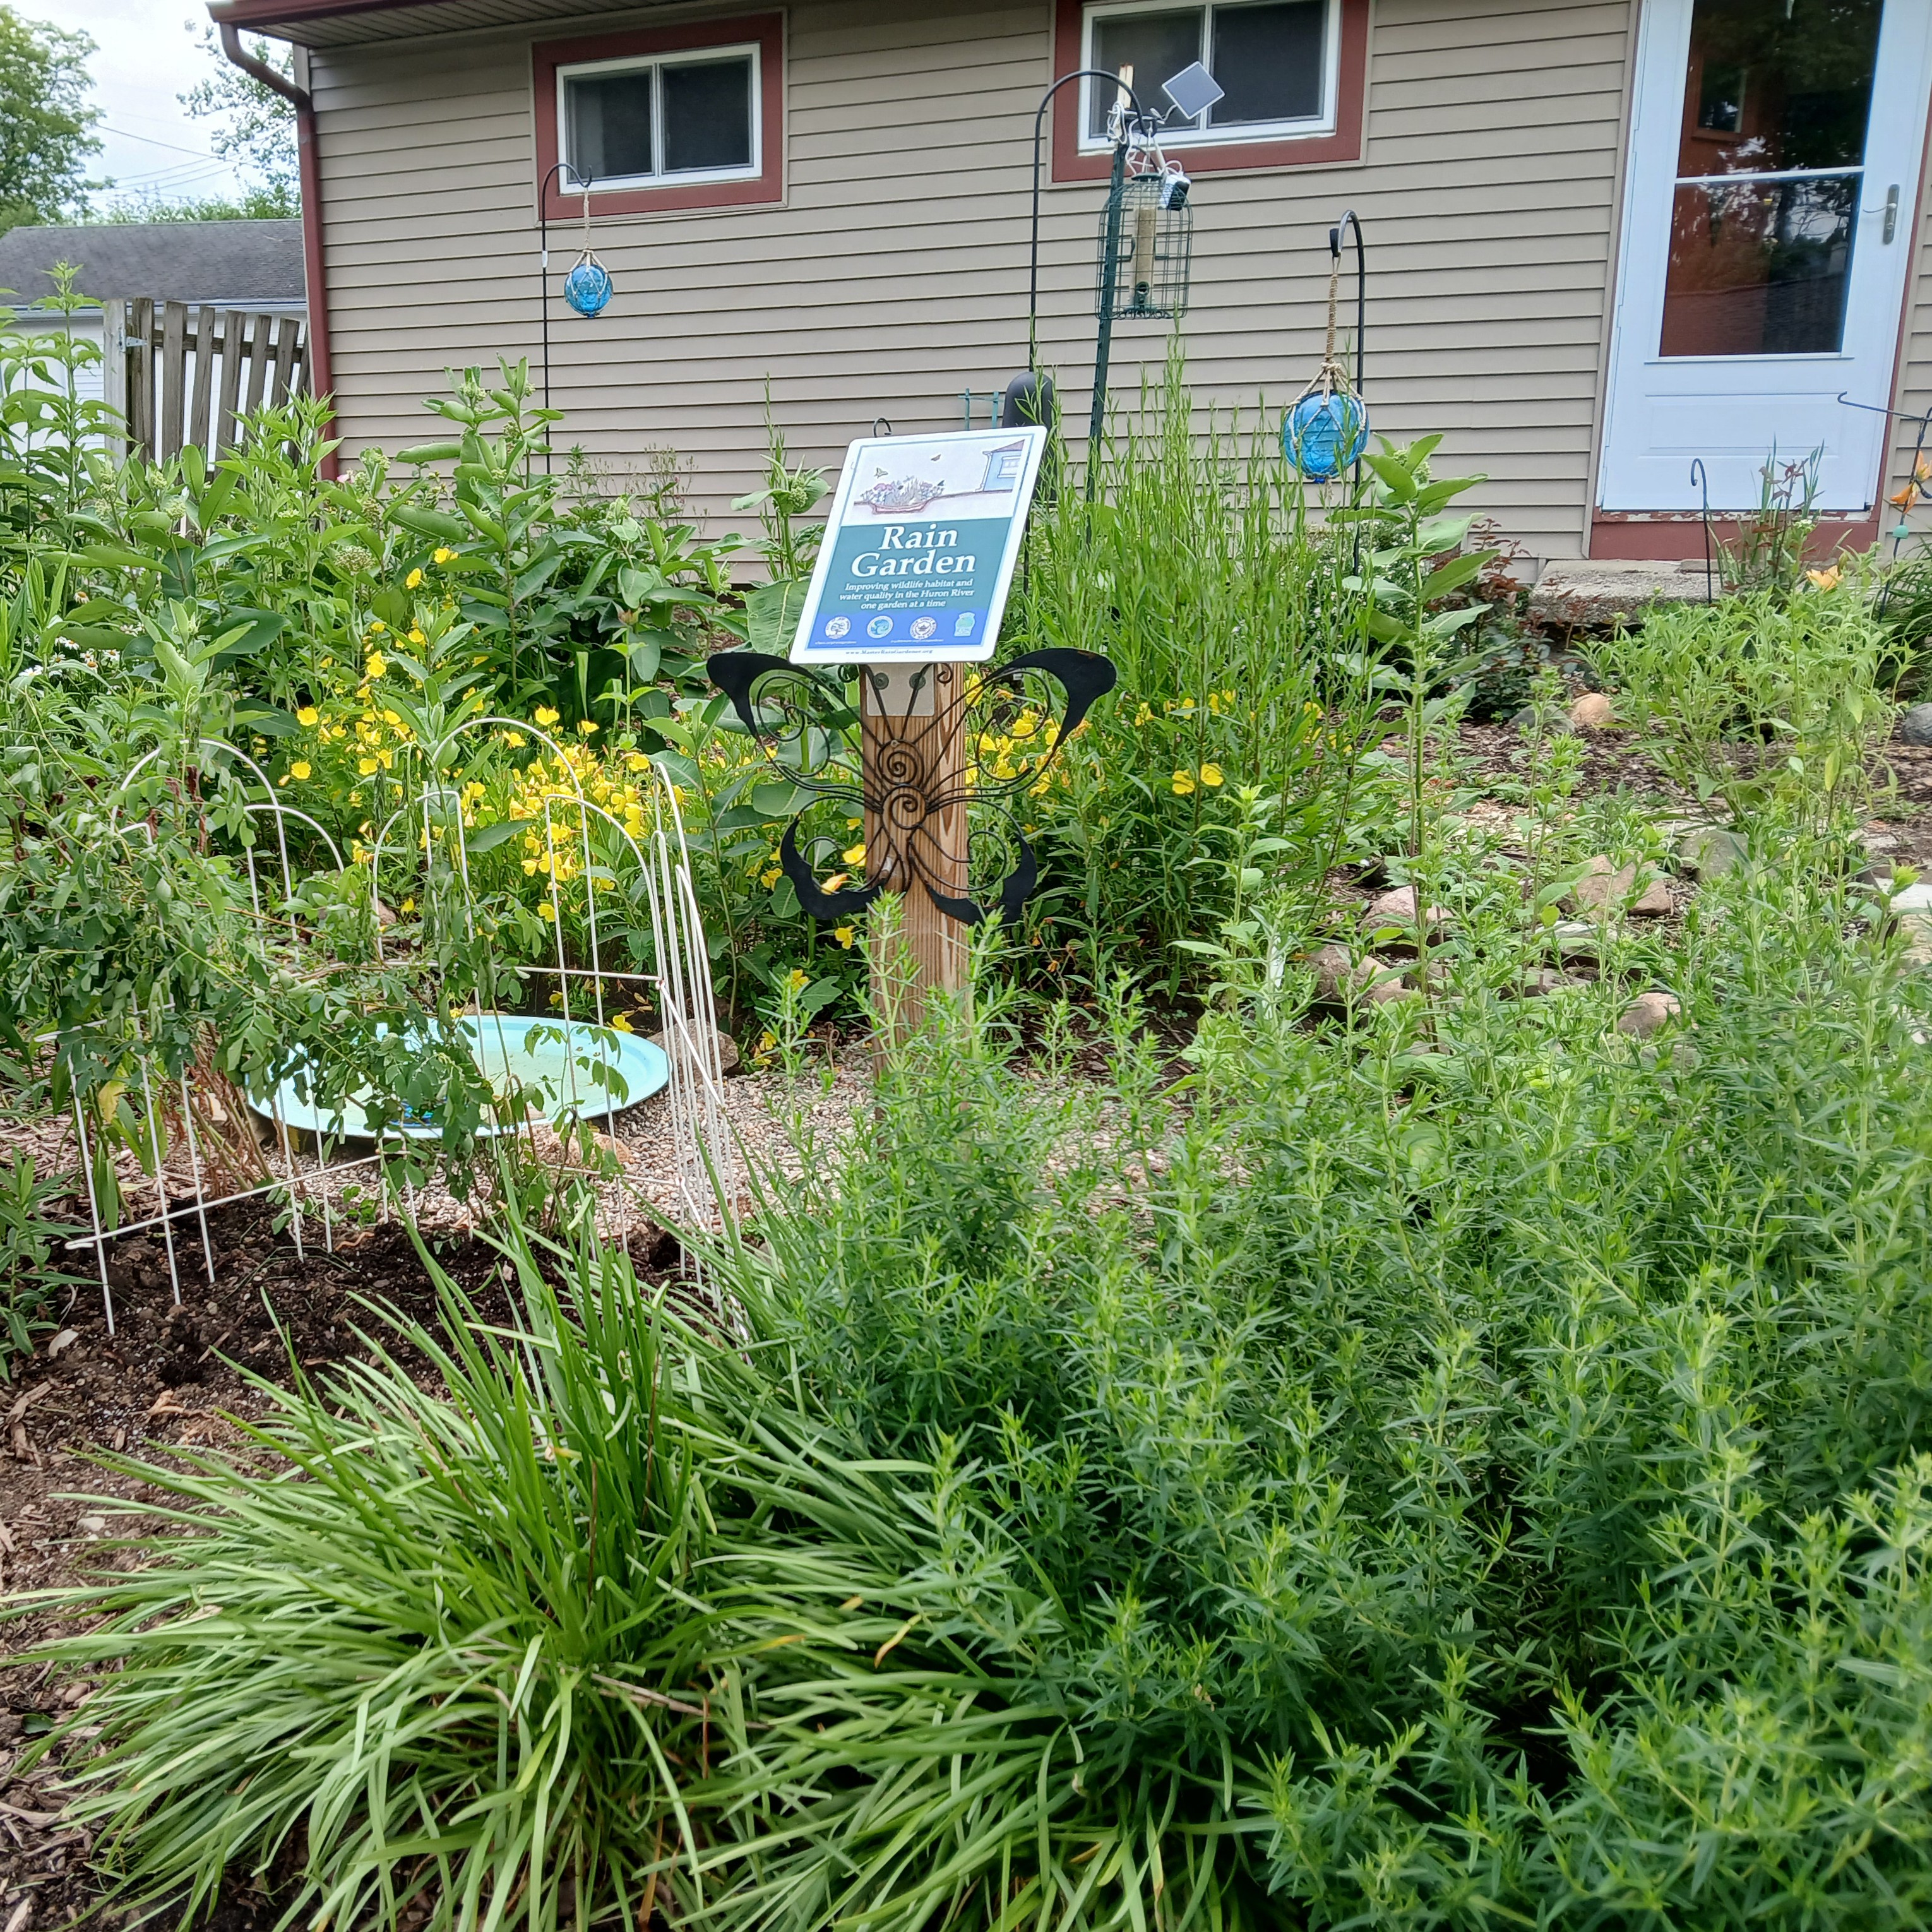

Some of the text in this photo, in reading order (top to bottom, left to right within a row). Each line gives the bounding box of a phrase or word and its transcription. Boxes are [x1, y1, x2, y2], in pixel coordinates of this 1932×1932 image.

[878, 523, 958, 550] Rain
[851, 549, 975, 577] Garden
[845, 578, 974, 592] Improving wildlife habitat and
[864, 592, 893, 601] quality
[950, 588, 975, 597] River
[877, 600, 907, 611] garden
